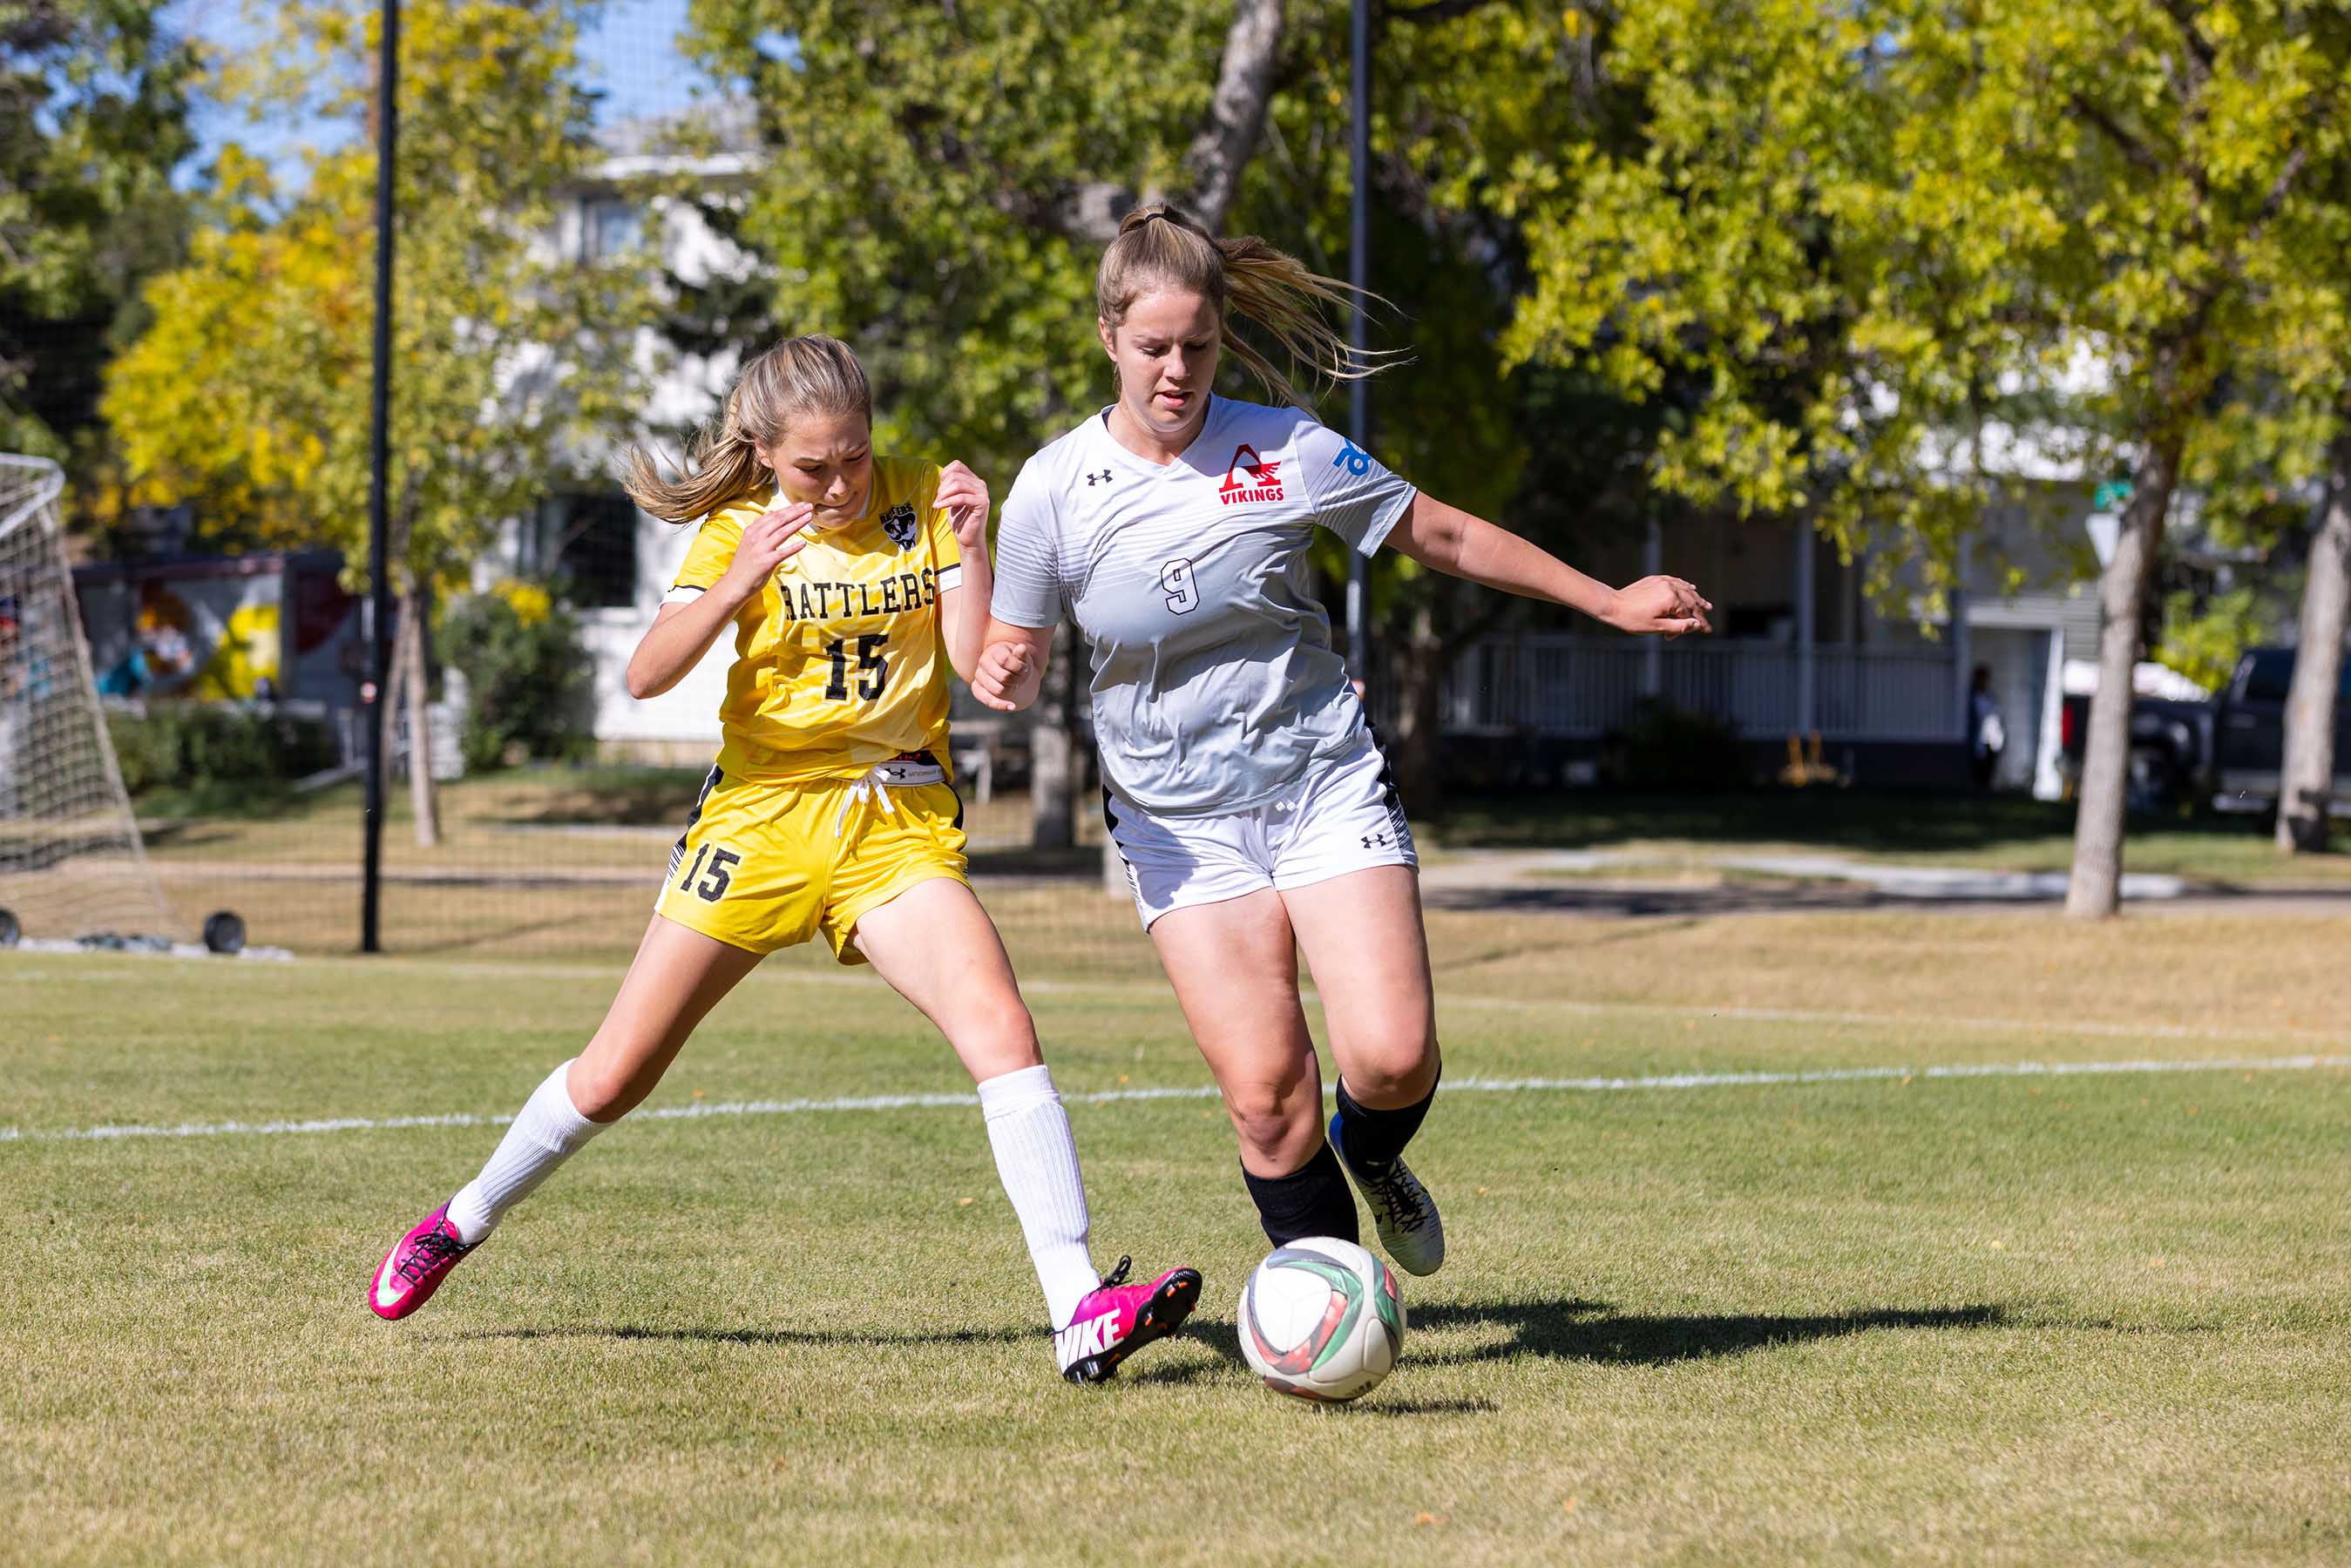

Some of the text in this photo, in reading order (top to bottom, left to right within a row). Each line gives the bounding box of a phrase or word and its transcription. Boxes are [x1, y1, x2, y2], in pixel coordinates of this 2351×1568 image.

[1220, 487, 1284, 505] VIKINGS
[781, 567, 935, 620] RATTLERS
[1160, 558, 1200, 616] 9
[824, 633, 889, 701] 15
[681, 842, 742, 902] 15
[1055, 1308, 1124, 1374] NIKE
